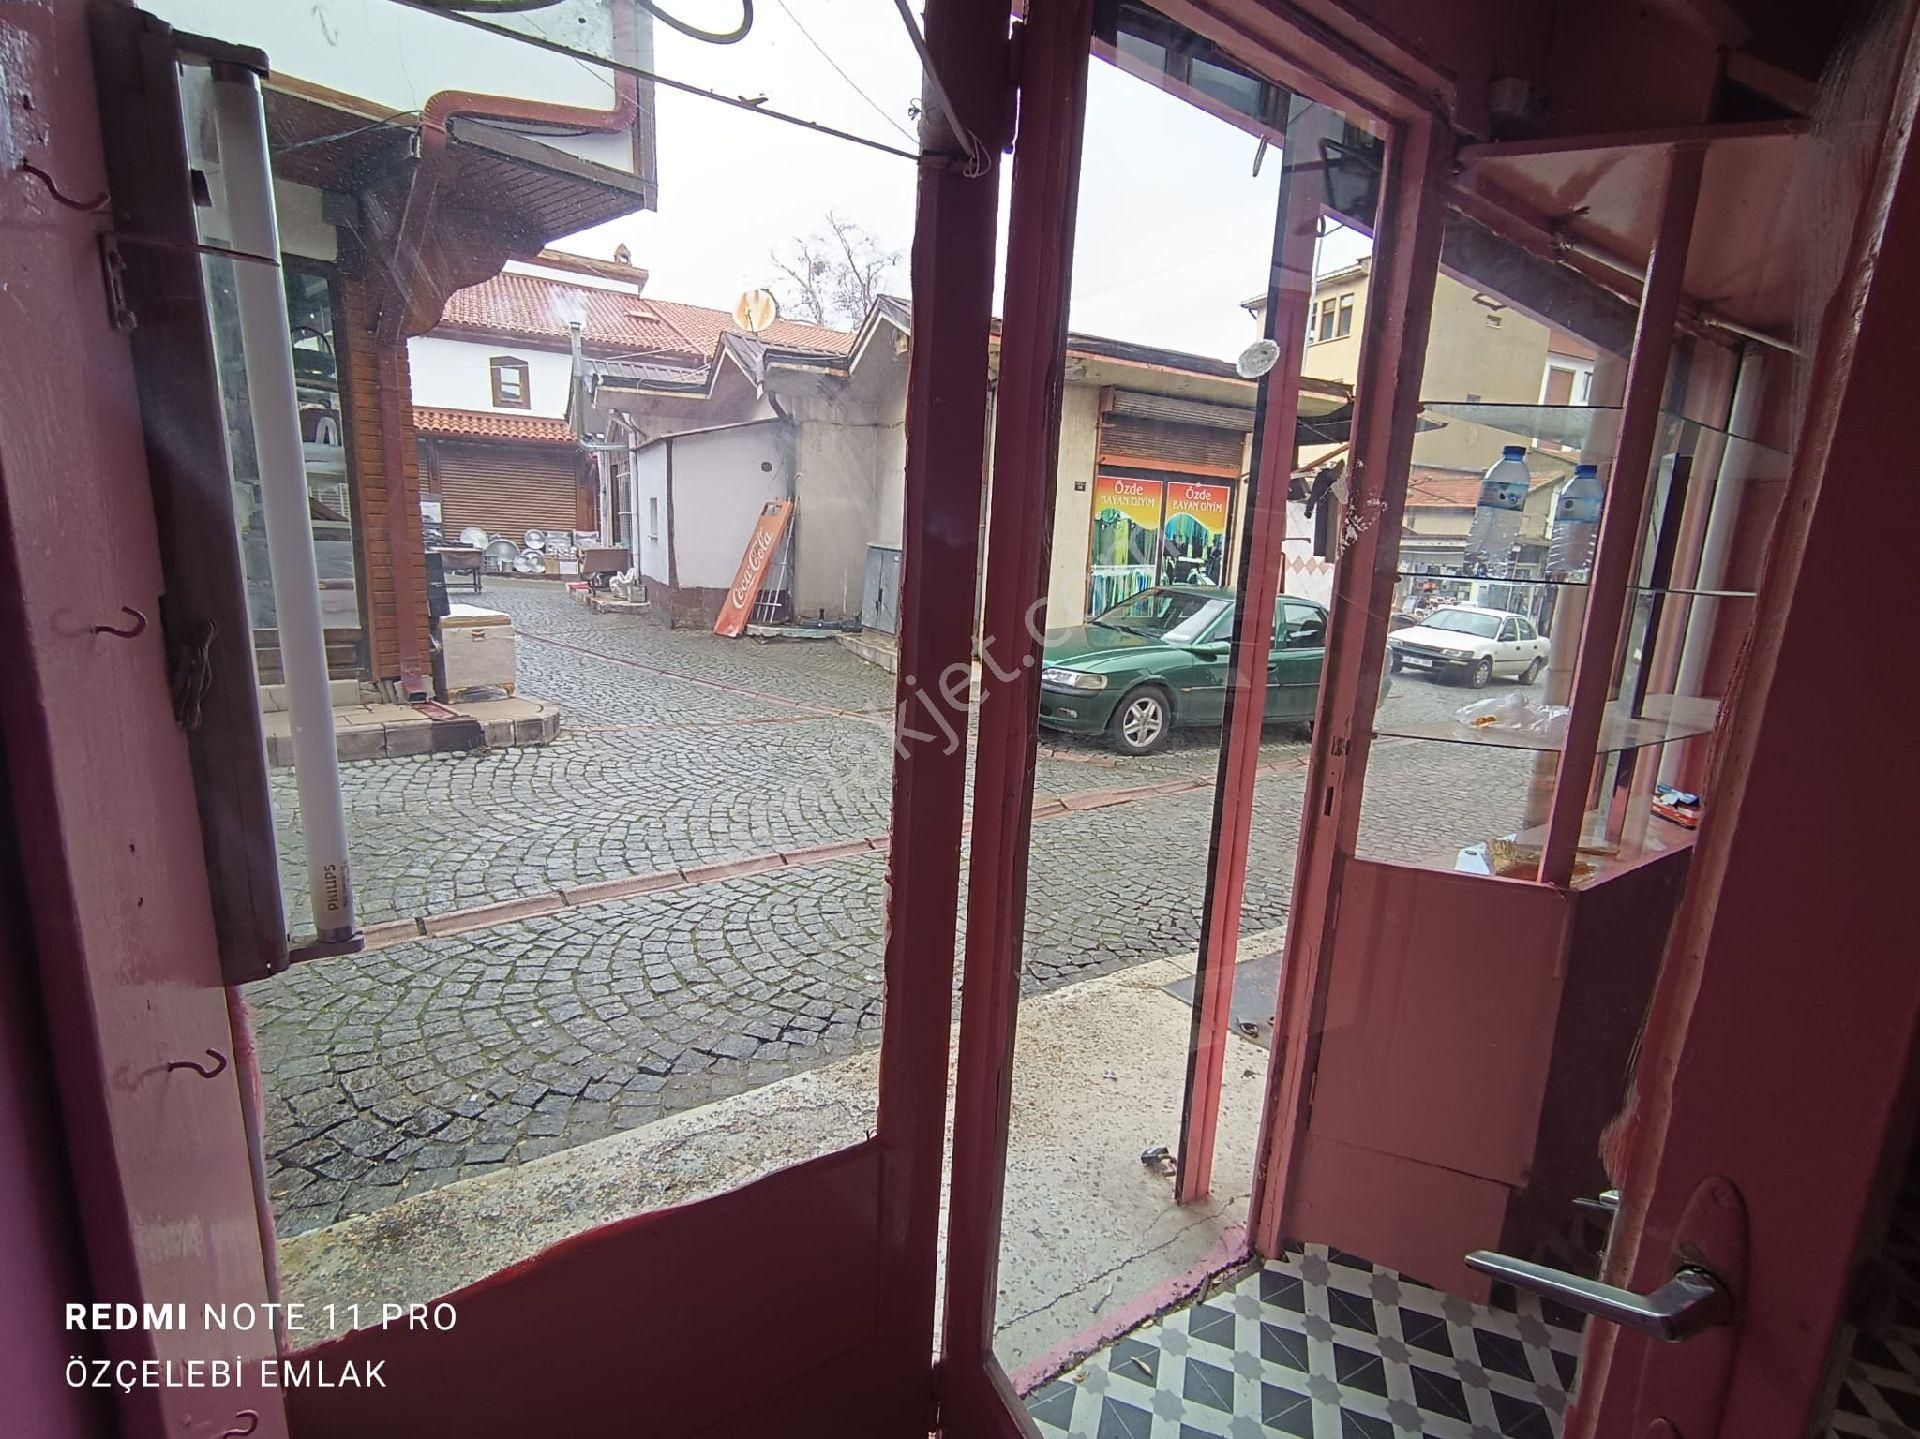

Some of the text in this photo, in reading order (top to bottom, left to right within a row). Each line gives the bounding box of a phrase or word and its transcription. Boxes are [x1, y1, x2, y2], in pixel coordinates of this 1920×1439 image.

[1114, 480, 1144, 496] Özde
[1185, 486, 1212, 501] Özde
[323, 864, 339, 911] PHILIPS
